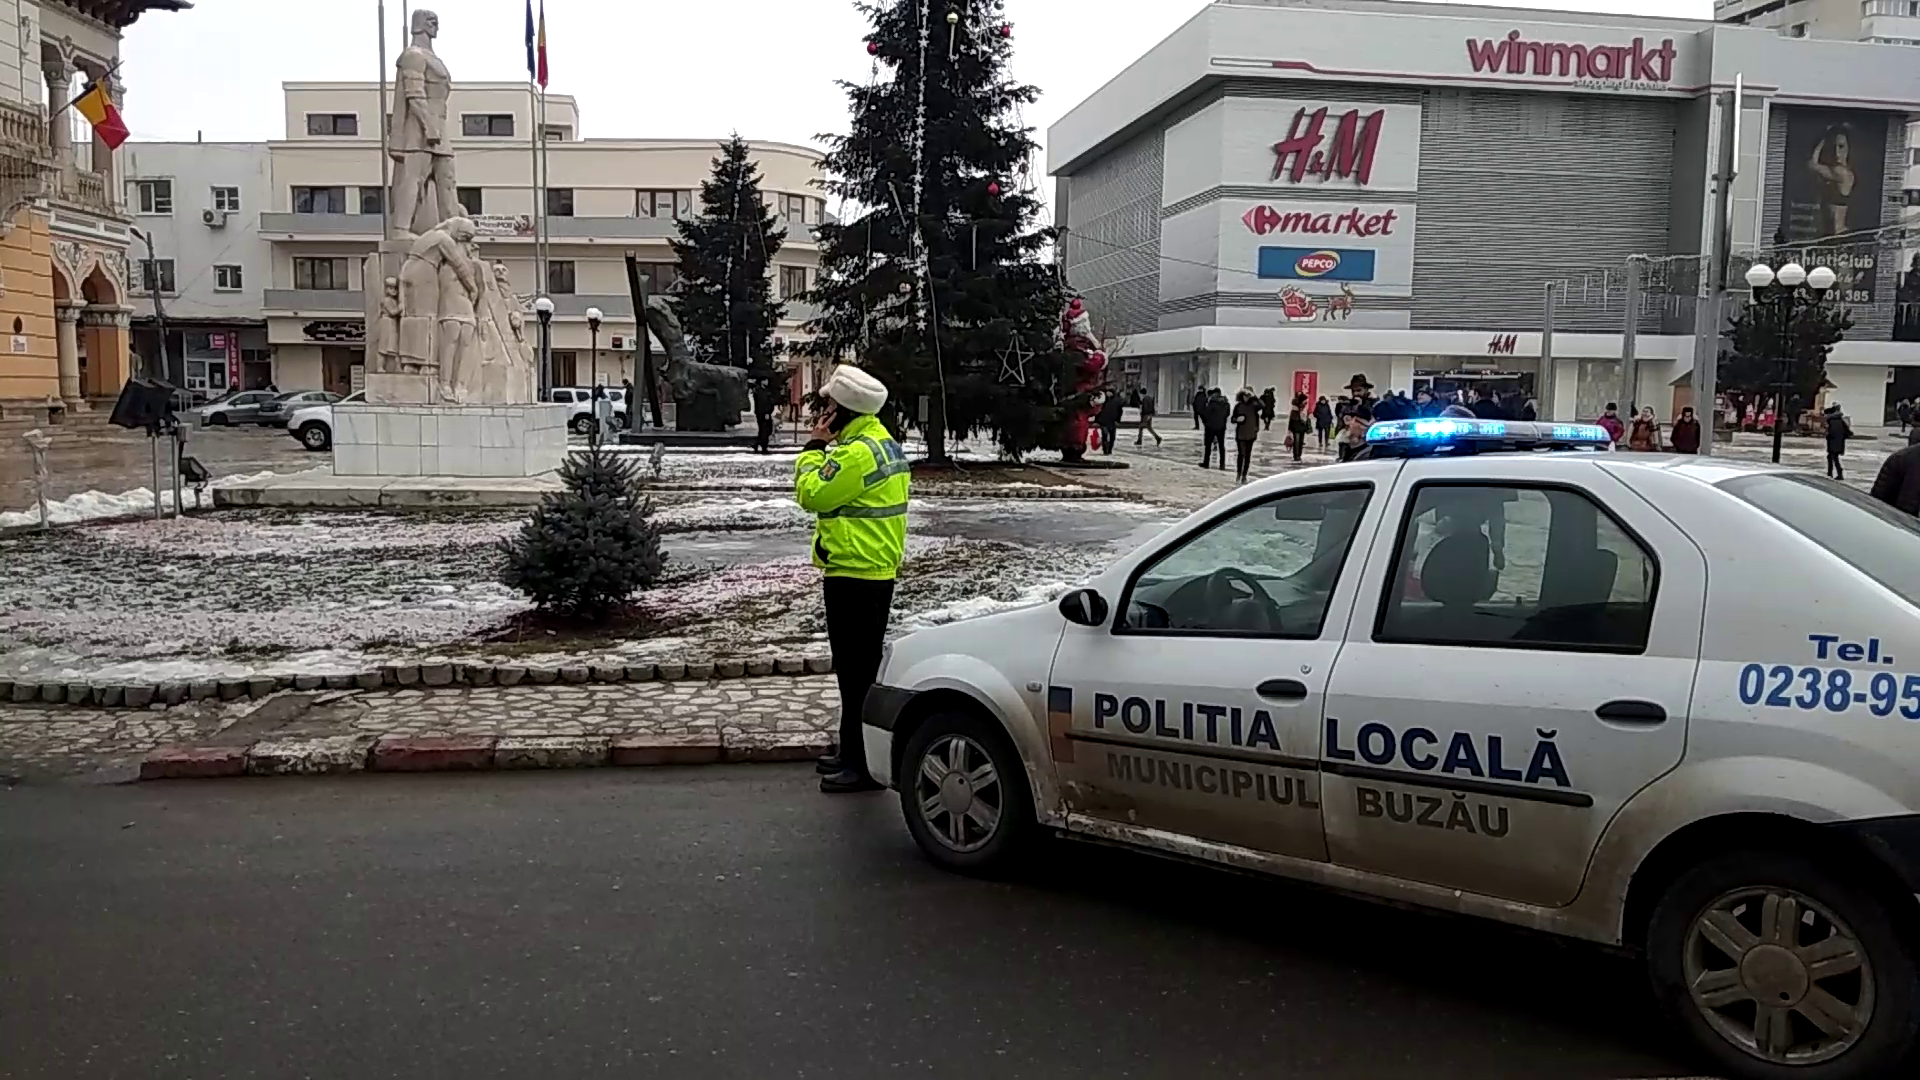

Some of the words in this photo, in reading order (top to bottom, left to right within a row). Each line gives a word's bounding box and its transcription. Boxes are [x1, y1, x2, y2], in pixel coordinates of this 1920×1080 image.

[1467, 29, 1677, 81] winmarkt
[1273, 107, 1385, 185] H&M
[1280, 207, 1397, 237] market
[1301, 258, 1333, 269] PEPCO
[1845, 290, 1869, 302] 385
[1488, 333, 1518, 354] H&M
[1809, 634, 1893, 664] Tel.
[1739, 663, 1920, 720] 0238-95
[1094, 692, 1282, 751] POLITIA
[1326, 717, 1572, 788] LOCALĂ
[1106, 753, 1319, 810] MUNICIPIUL
[1356, 786, 1510, 838] BUZĂU
